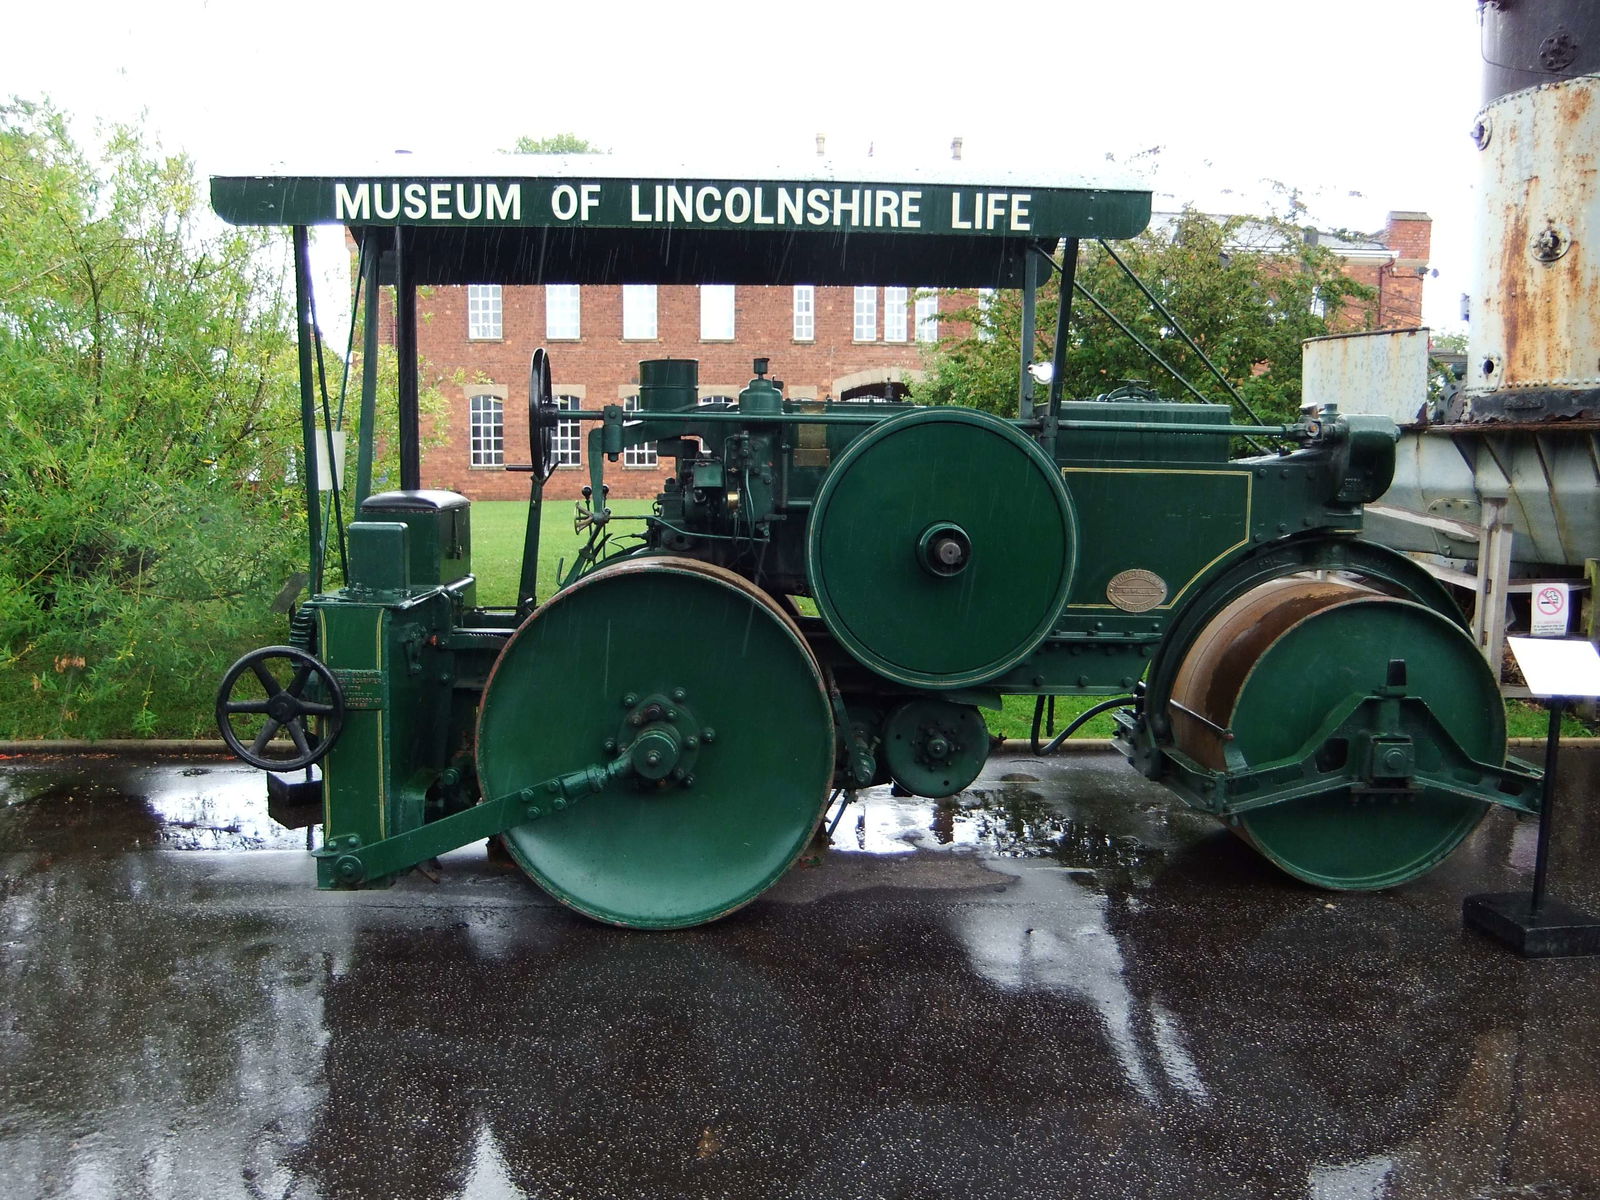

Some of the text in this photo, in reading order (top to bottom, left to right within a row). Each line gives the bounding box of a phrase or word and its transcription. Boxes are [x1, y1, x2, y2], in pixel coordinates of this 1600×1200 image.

[335, 183, 1032, 231] MUSEUM OF LINCOLNSHIRE LIFE
